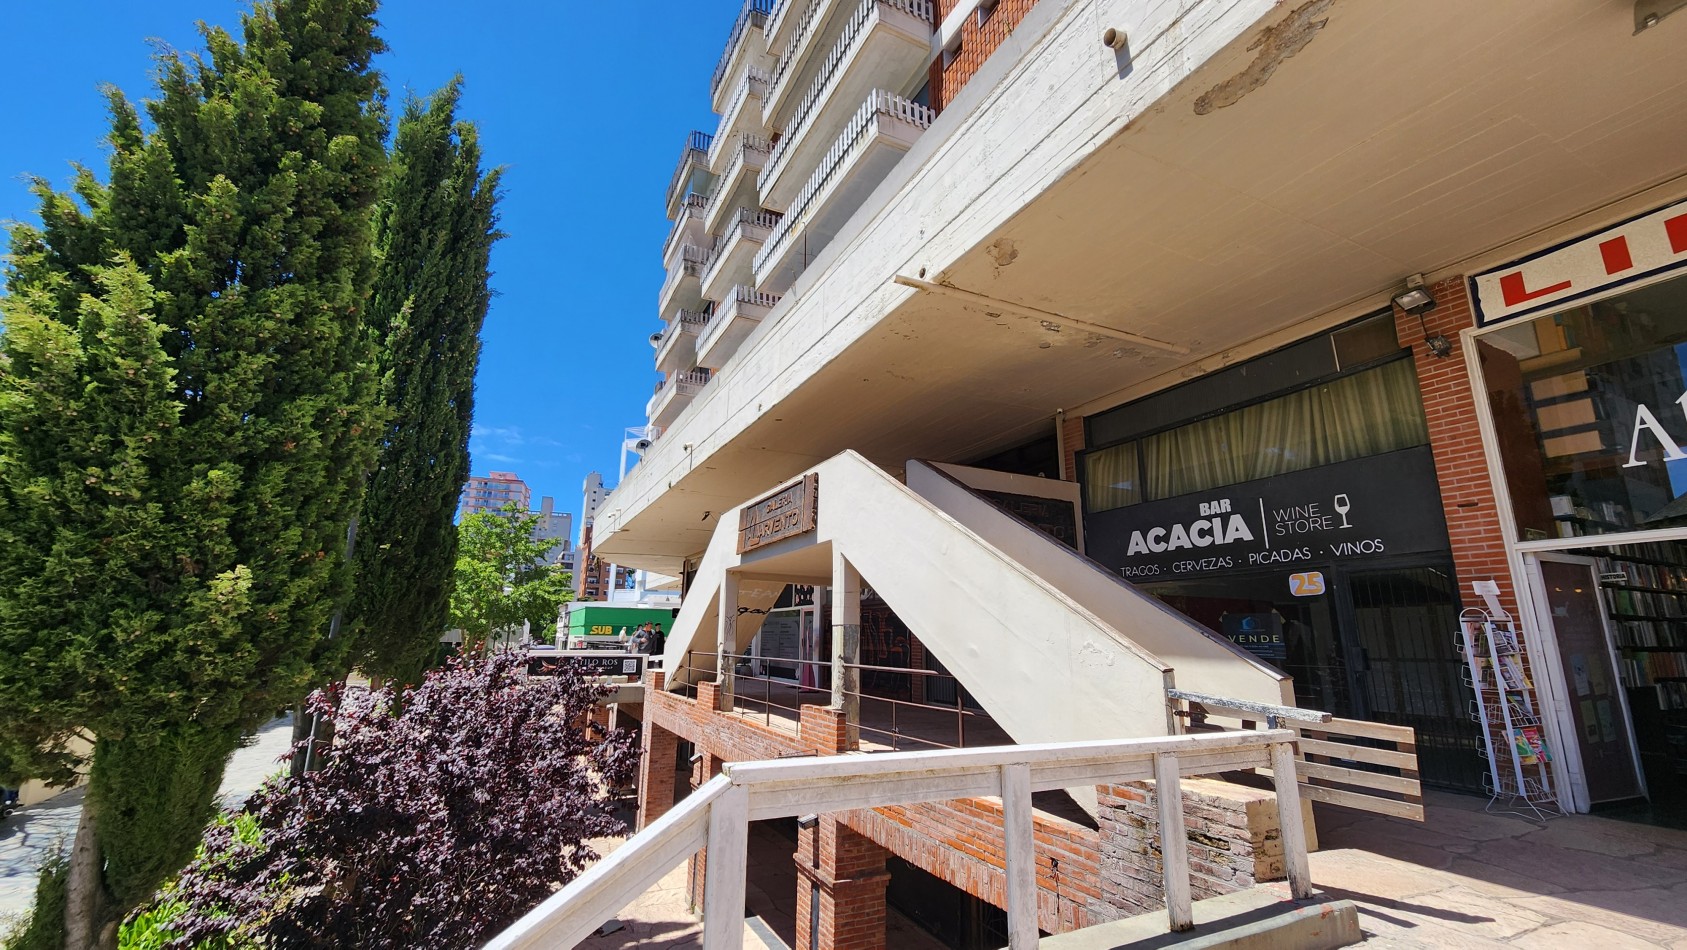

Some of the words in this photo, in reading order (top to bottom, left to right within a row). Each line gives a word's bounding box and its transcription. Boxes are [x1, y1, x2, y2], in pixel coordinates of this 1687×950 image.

[1199, 499, 1232, 517] BAR
[1273, 502, 1321, 522] WINE
[1126, 514, 1254, 556] ACACIA
[1275, 515, 1334, 536] STORE
[1120, 564, 1160, 578] TRAGOS
[1172, 556, 1233, 574] CERVEZAS
[1248, 547, 1311, 566] PICADAS
[1330, 538, 1384, 557] VINOS
[1291, 574, 1323, 595] 25
[590, 625, 612, 635] SUB
[1228, 634, 1281, 643] VENDE
[602, 658, 618, 666] ROS
